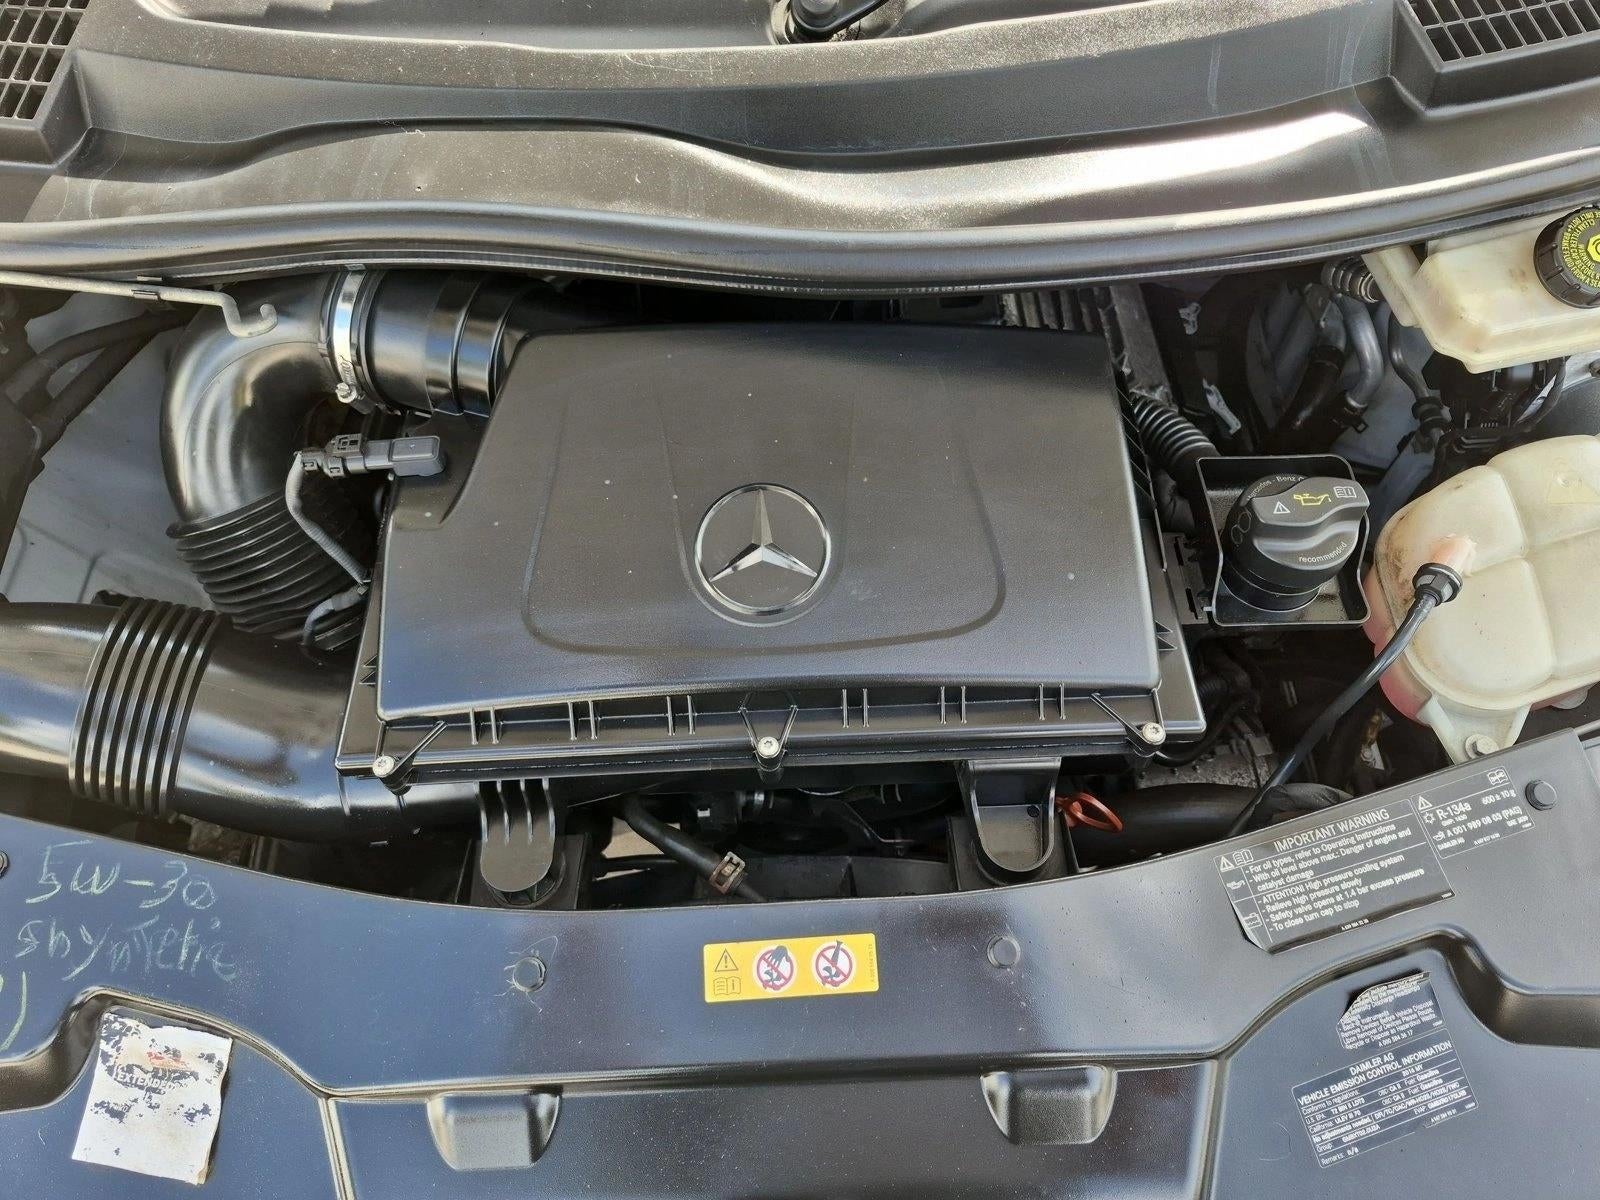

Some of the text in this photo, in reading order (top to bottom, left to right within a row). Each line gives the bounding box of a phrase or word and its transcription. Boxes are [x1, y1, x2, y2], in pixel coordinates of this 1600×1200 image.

[1299, 541, 1348, 563] recommended
[1436, 802, 1471, 819] R-134a
[1500, 790, 1510, 798] 10
[1274, 809, 1389, 852] IMPORTANT WARNING
[1452, 825, 1467, 834] 001
[1249, 865, 1261, 873] For
[1263, 860, 1272, 869] oil
[1321, 837, 1356, 851] Operating
[1355, 824, 1395, 840] Instructions
[1252, 872, 1270, 882] With
[1271, 868, 1280, 877] oil
[1279, 862, 1297, 874] level
[1298, 858, 1319, 868] above
[1339, 842, 1364, 856] Danger
[1366, 839, 1373, 847] of
[1374, 834, 1397, 845] engine
[1397, 827, 1411, 837] and
[1257, 870, 1314, 891] catalyst damage
[1305, 880, 1322, 890] High
[1323, 871, 1353, 886] pressure
[1354, 863, 1380, 875] cooling
[1379, 855, 1404, 867] system
[1266, 878, 1362, 912] Relieve high pressure slowly
[1270, 869, 1424, 922] Safety valve opens at 1.4 bar excess pressure
[1284, 917, 1303, 927] close
[1304, 912, 1319, 921] turn
[1320, 908, 1334, 916] cap
[1343, 899, 1359, 909] stop
[1298, 1041, 1451, 1105] VEHICLE EMISSION CONTROL INFORMATION
[1350, 1052, 1394, 1075] DAIMLER AG
[1416, 1069, 1439, 1081] Gasoline
[1419, 1077, 1443, 1090] Gasoline
